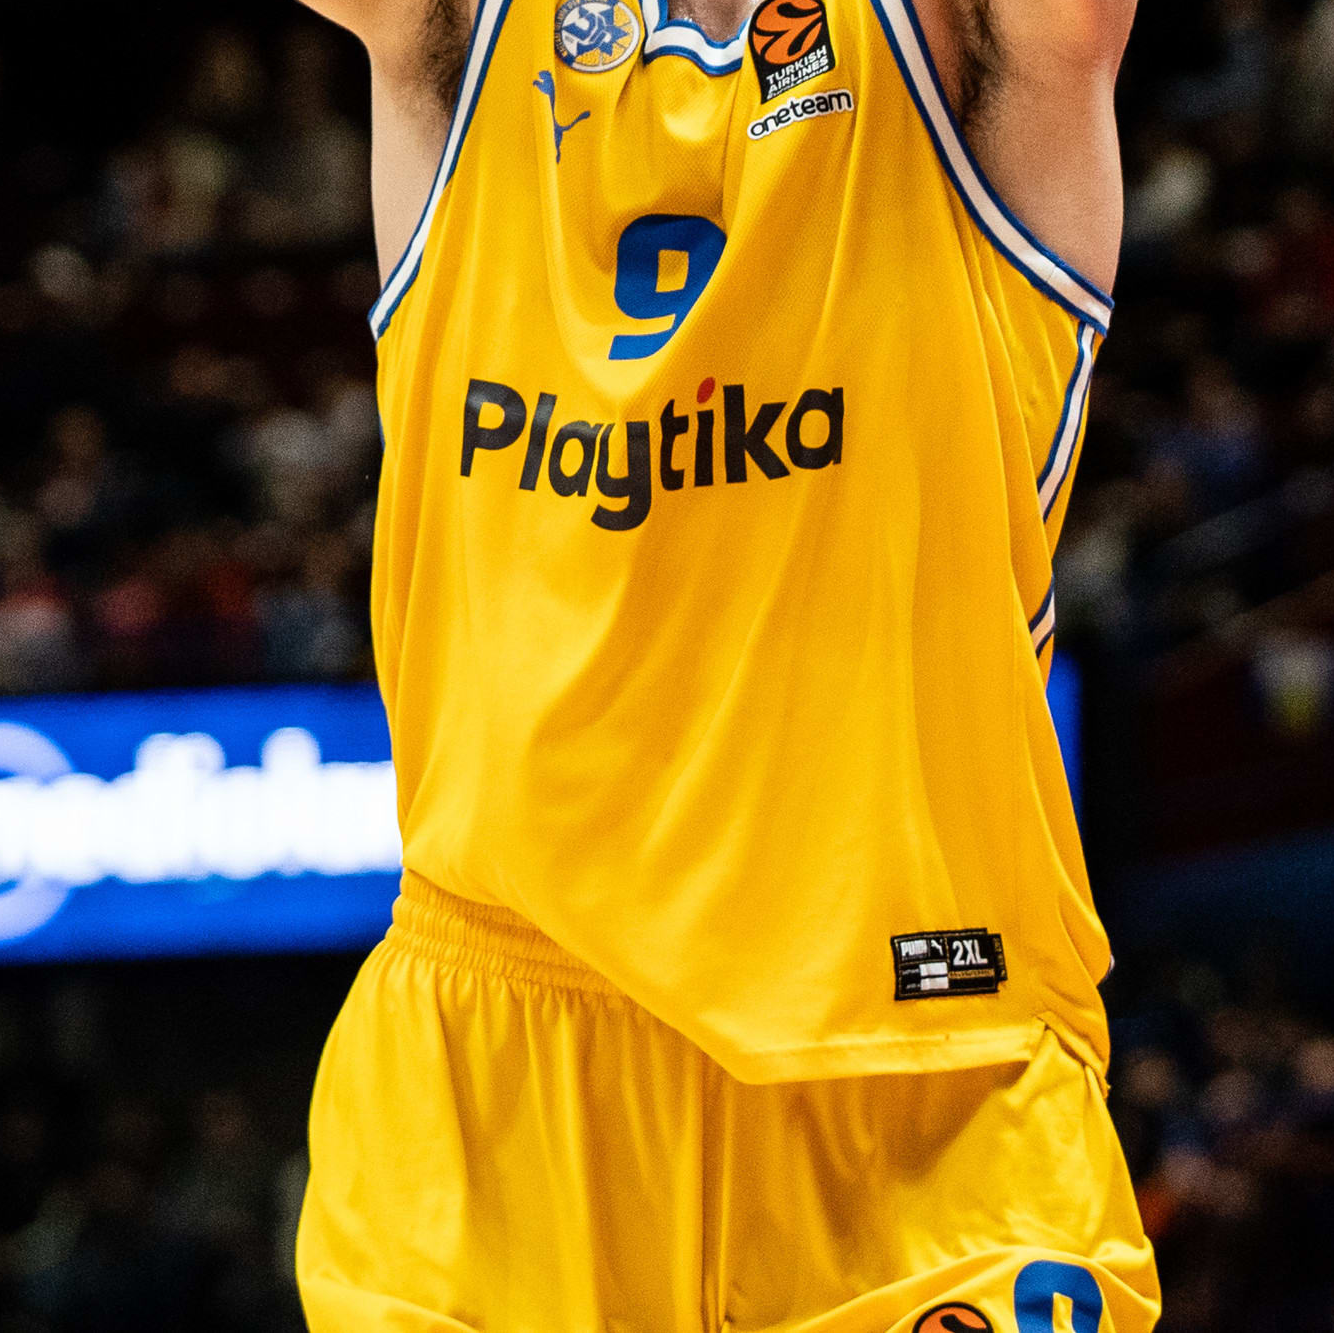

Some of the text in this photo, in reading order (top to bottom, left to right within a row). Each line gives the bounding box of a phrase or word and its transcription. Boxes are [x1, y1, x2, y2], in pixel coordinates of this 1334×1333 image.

[767, 45, 827, 84] TURKISH
[768, 56, 829, 95] AIRLINES
[750, 91, 852, 136] oneteam
[608, 214, 726, 360] 9
[460, 377, 844, 531] Playtika
[952, 939, 988, 966] 2XL
